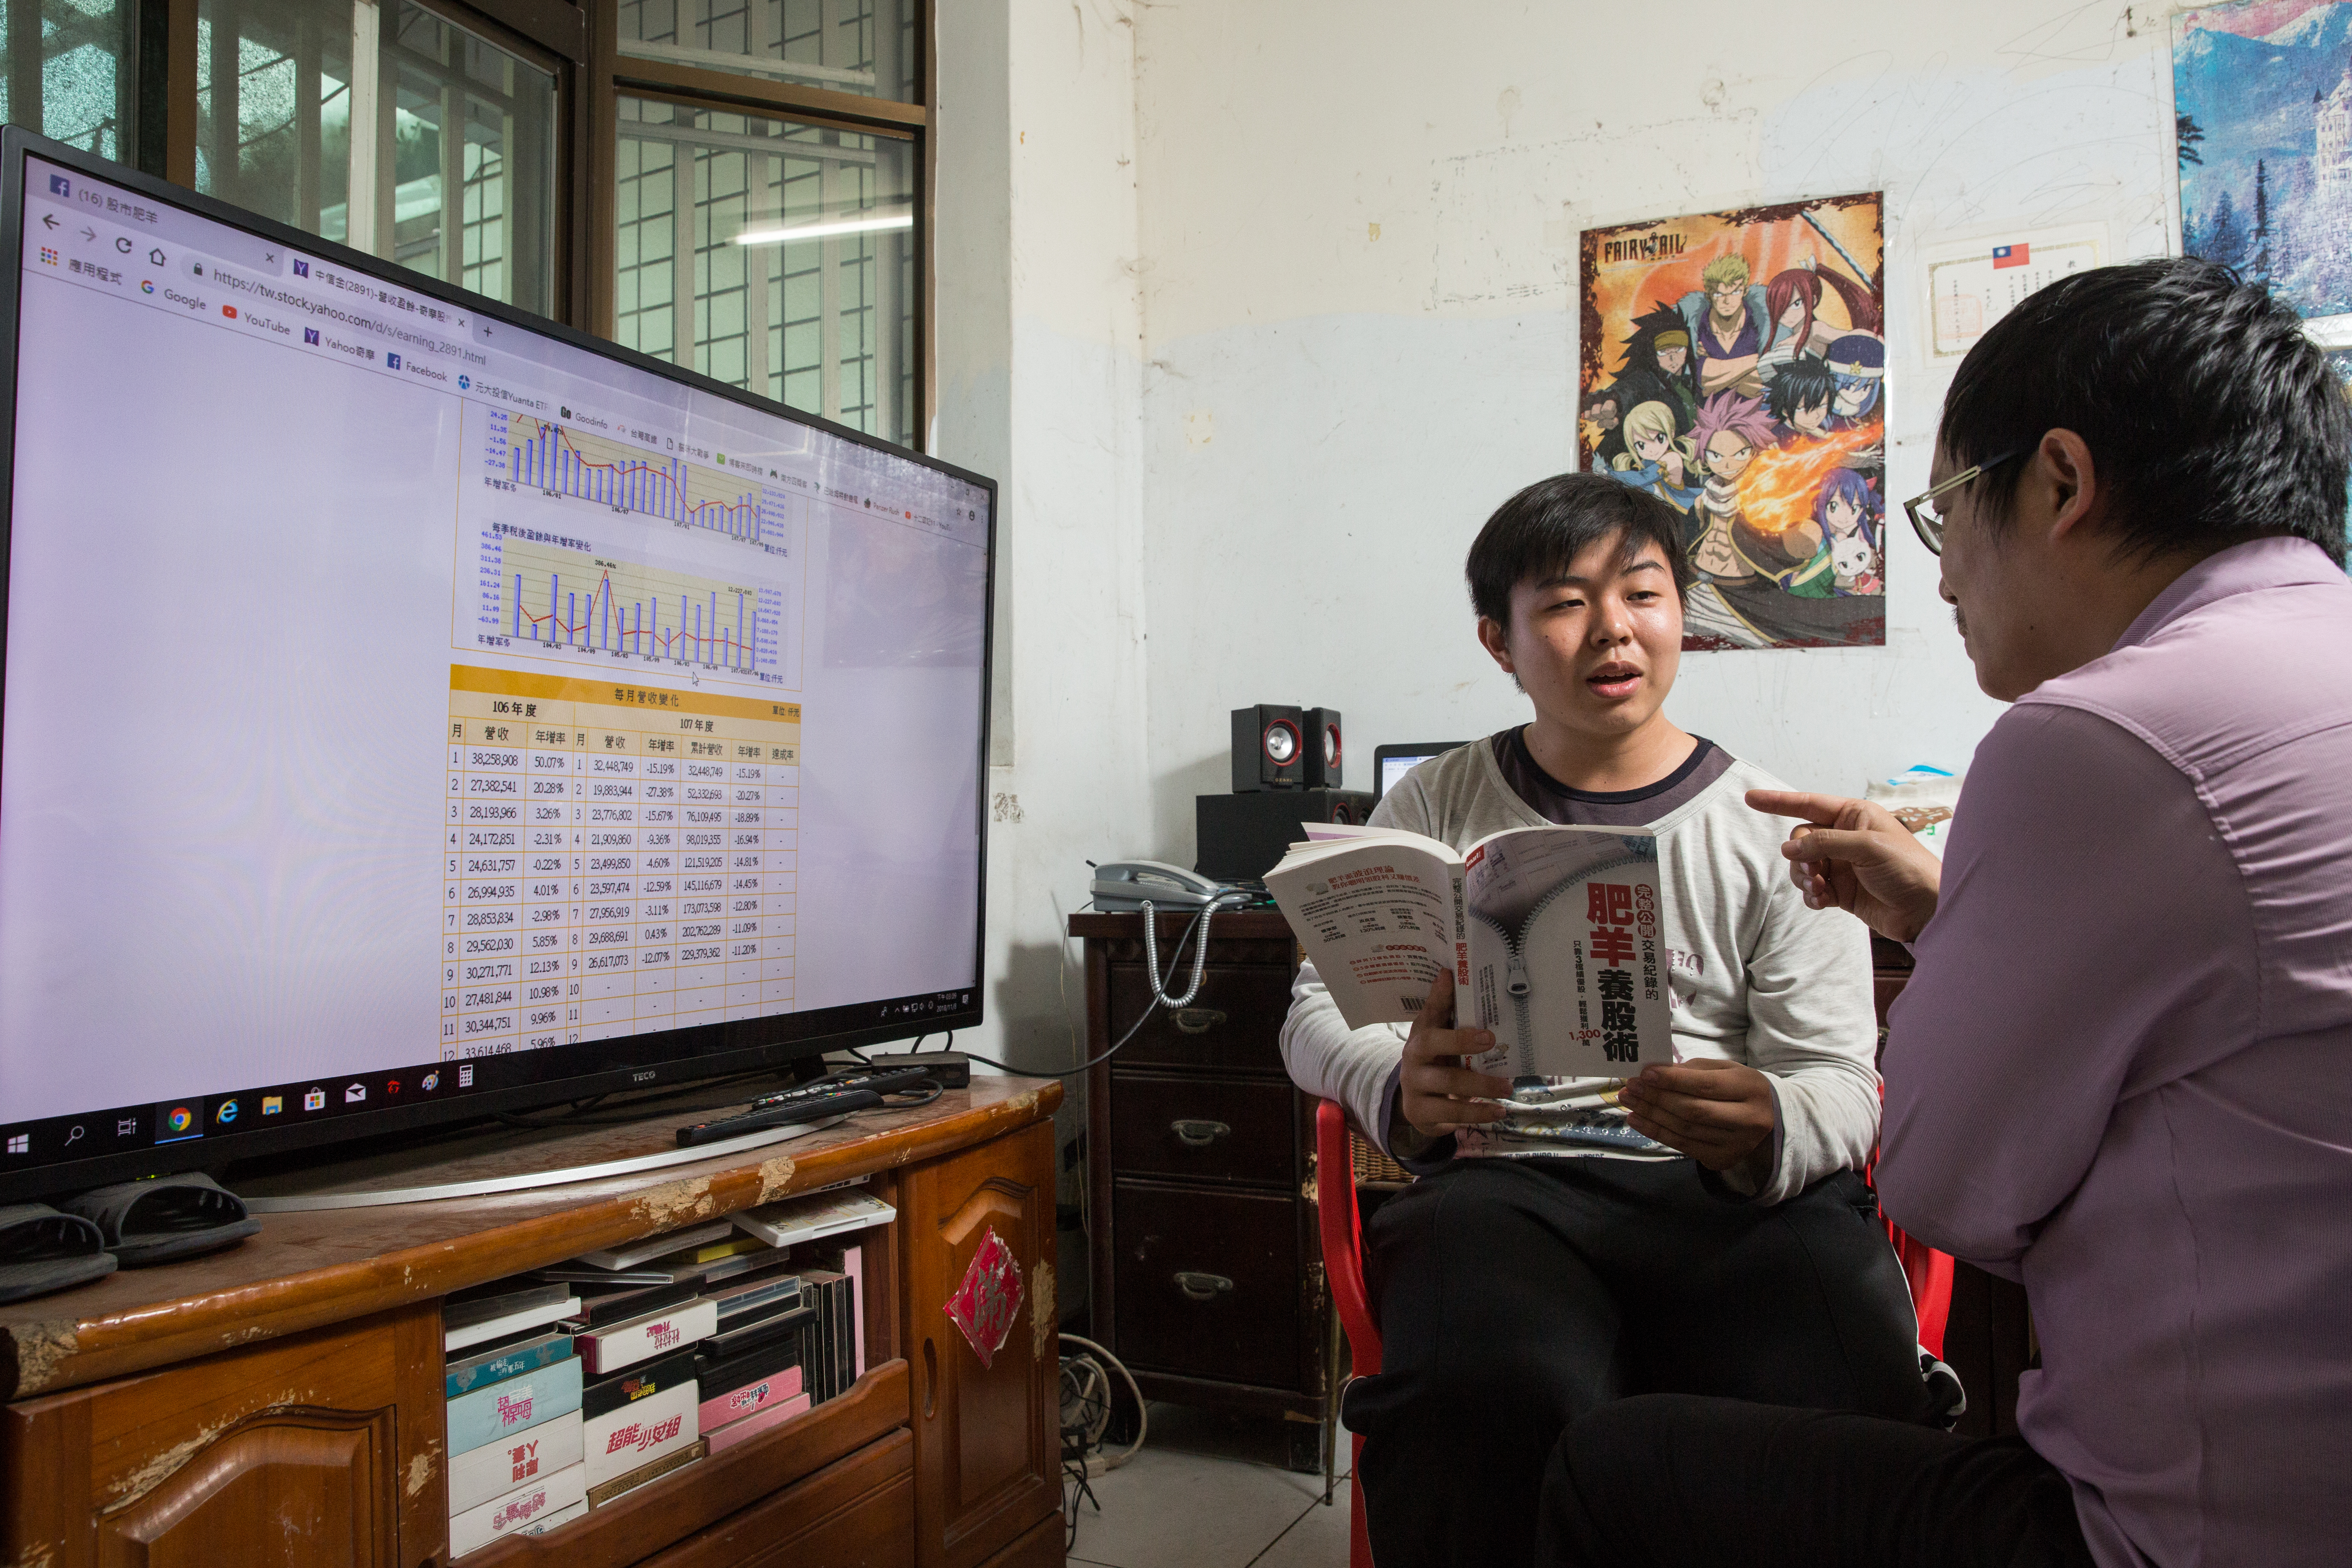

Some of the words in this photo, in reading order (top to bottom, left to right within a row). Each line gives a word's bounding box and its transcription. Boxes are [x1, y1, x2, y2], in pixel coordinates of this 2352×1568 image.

[78, 189, 102, 208] (16)
[107, 196, 158, 224] 股市肥羊
[1605, 239, 1647, 263] FAIRY
[1649, 232, 1688, 257] TAIL
[69, 258, 122, 285] 應用程式
[165, 289, 206, 310] Google
[214, 268, 486, 365] https://tw.stock.yahoo.com/d/s/earning_2891.html
[245, 312, 290, 337] YouTube
[325, 337, 375, 361] Yahoo奇摩
[406, 361, 448, 383] Facebook
[576, 413, 608, 430] Goodinfo
[484, 476, 516, 492] 年增率%
[492, 522, 591, 552] 每季稅後盈餘與年增率變化
[478, 634, 510, 647] 年增率%
[615, 688, 678, 706] 每月營收變化
[452, 724, 461, 737] 月
[485, 726, 508, 740] 營收
[536, 730, 565, 744] 年增率
[577, 733, 584, 746] 月
[605, 735, 625, 748] 營收
[649, 739, 674, 751] 年增率
[691, 742, 722, 755] 累計營收
[738, 746, 760, 757] 年增率
[454, 752, 457, 763] 1
[472, 753, 518, 766] 38,258,908
[535, 756, 564, 768] 50.07%
[594, 760, 633, 773] 32,448,749
[647, 763, 674, 774] -15.19%
[688, 766, 722, 777] 32,448,749
[737, 768, 760, 778] -15.19%
[452, 779, 458, 790] 2
[471, 780, 516, 793] 27,382,541
[534, 782, 564, 793] 20.28%
[594, 785, 632, 797] 19,883,944
[646, 787, 673, 797] -27.38%
[688, 788, 722, 800] 52,332,693
[736, 791, 760, 800] -20.27%
[452, 806, 457, 817] 3
[470, 806, 517, 819] 28,193,966
[536, 808, 560, 819] 3.26%
[592, 809, 632, 821] 23,776,802
[646, 811, 673, 821] -15.67%
[687, 811, 721, 822] 76,109,495
[735, 813, 760, 822] -18.89%
[450, 833, 456, 844] 4
[470, 833, 514, 846] 24,172,851
[534, 833, 561, 844] -2.31%
[592, 834, 631, 845] 21,909,860
[647, 834, 670, 844] -9.36%
[686, 835, 721, 845] 98,019,355
[735, 835, 759, 844] -16.94%
[450, 860, 455, 872] 5
[469, 860, 515, 872] 24,631,757
[533, 859, 561, 870] -0.22%
[591, 858, 630, 870] 23,499,850
[647, 858, 670, 868] -4.60%
[685, 857, 722, 868] 121,519,205
[734, 857, 758, 866] -14.81%
[449, 887, 455, 899] 6
[468, 886, 514, 899] 26,994,935
[534, 884, 558, 895] 4.01%
[590, 882, 630, 895] 23,597,474
[644, 881, 671, 892] -12.59%
[684, 880, 722, 891] 145,116,679
[734, 879, 758, 889] -14.45%
[448, 915, 454, 926] 7
[468, 912, 514, 926] 28,853,834
[532, 910, 560, 922] -2.98%
[590, 906, 629, 919] 27,956,919
[646, 904, 668, 915] -3.11%
[684, 902, 721, 914] 173,073,598
[733, 900, 757, 911] -12.80%
[448, 942, 454, 953] 8
[467, 938, 513, 953] 29,562,030
[533, 935, 557, 947] 5.85%
[589, 931, 628, 944] 29,688,691
[645, 928, 667, 940] 0.43%
[683, 925, 721, 937] 202,762,289
[733, 922, 757, 933] -11.09%
[447, 969, 453, 981] 9
[467, 964, 512, 980] 30,271,771
[530, 960, 559, 973] 12.13%
[589, 955, 628, 969] 26,617,073
[642, 951, 670, 963] -12.07%
[682, 947, 720, 960] 229,379,362
[732, 944, 756, 956] -11.20%
[1456, 942, 1469, 986] 肥羊養股術
[445, 996, 455, 1008] 10
[466, 991, 512, 1006] 27,481,844
[530, 985, 559, 999] 10.98%
[444, 1024, 454, 1036] 11
[466, 1017, 510, 1033] 30,344,751
[531, 1011, 556, 1025] 9.96%
[1569, 1029, 1601, 1041] 1,300
[633, 1071, 655, 1082] TECO
[606, 1415, 682, 1455] 超能少女組
[512, 1457, 539, 1483] 犀利
[493, 1492, 546, 1530] 絕對達令
